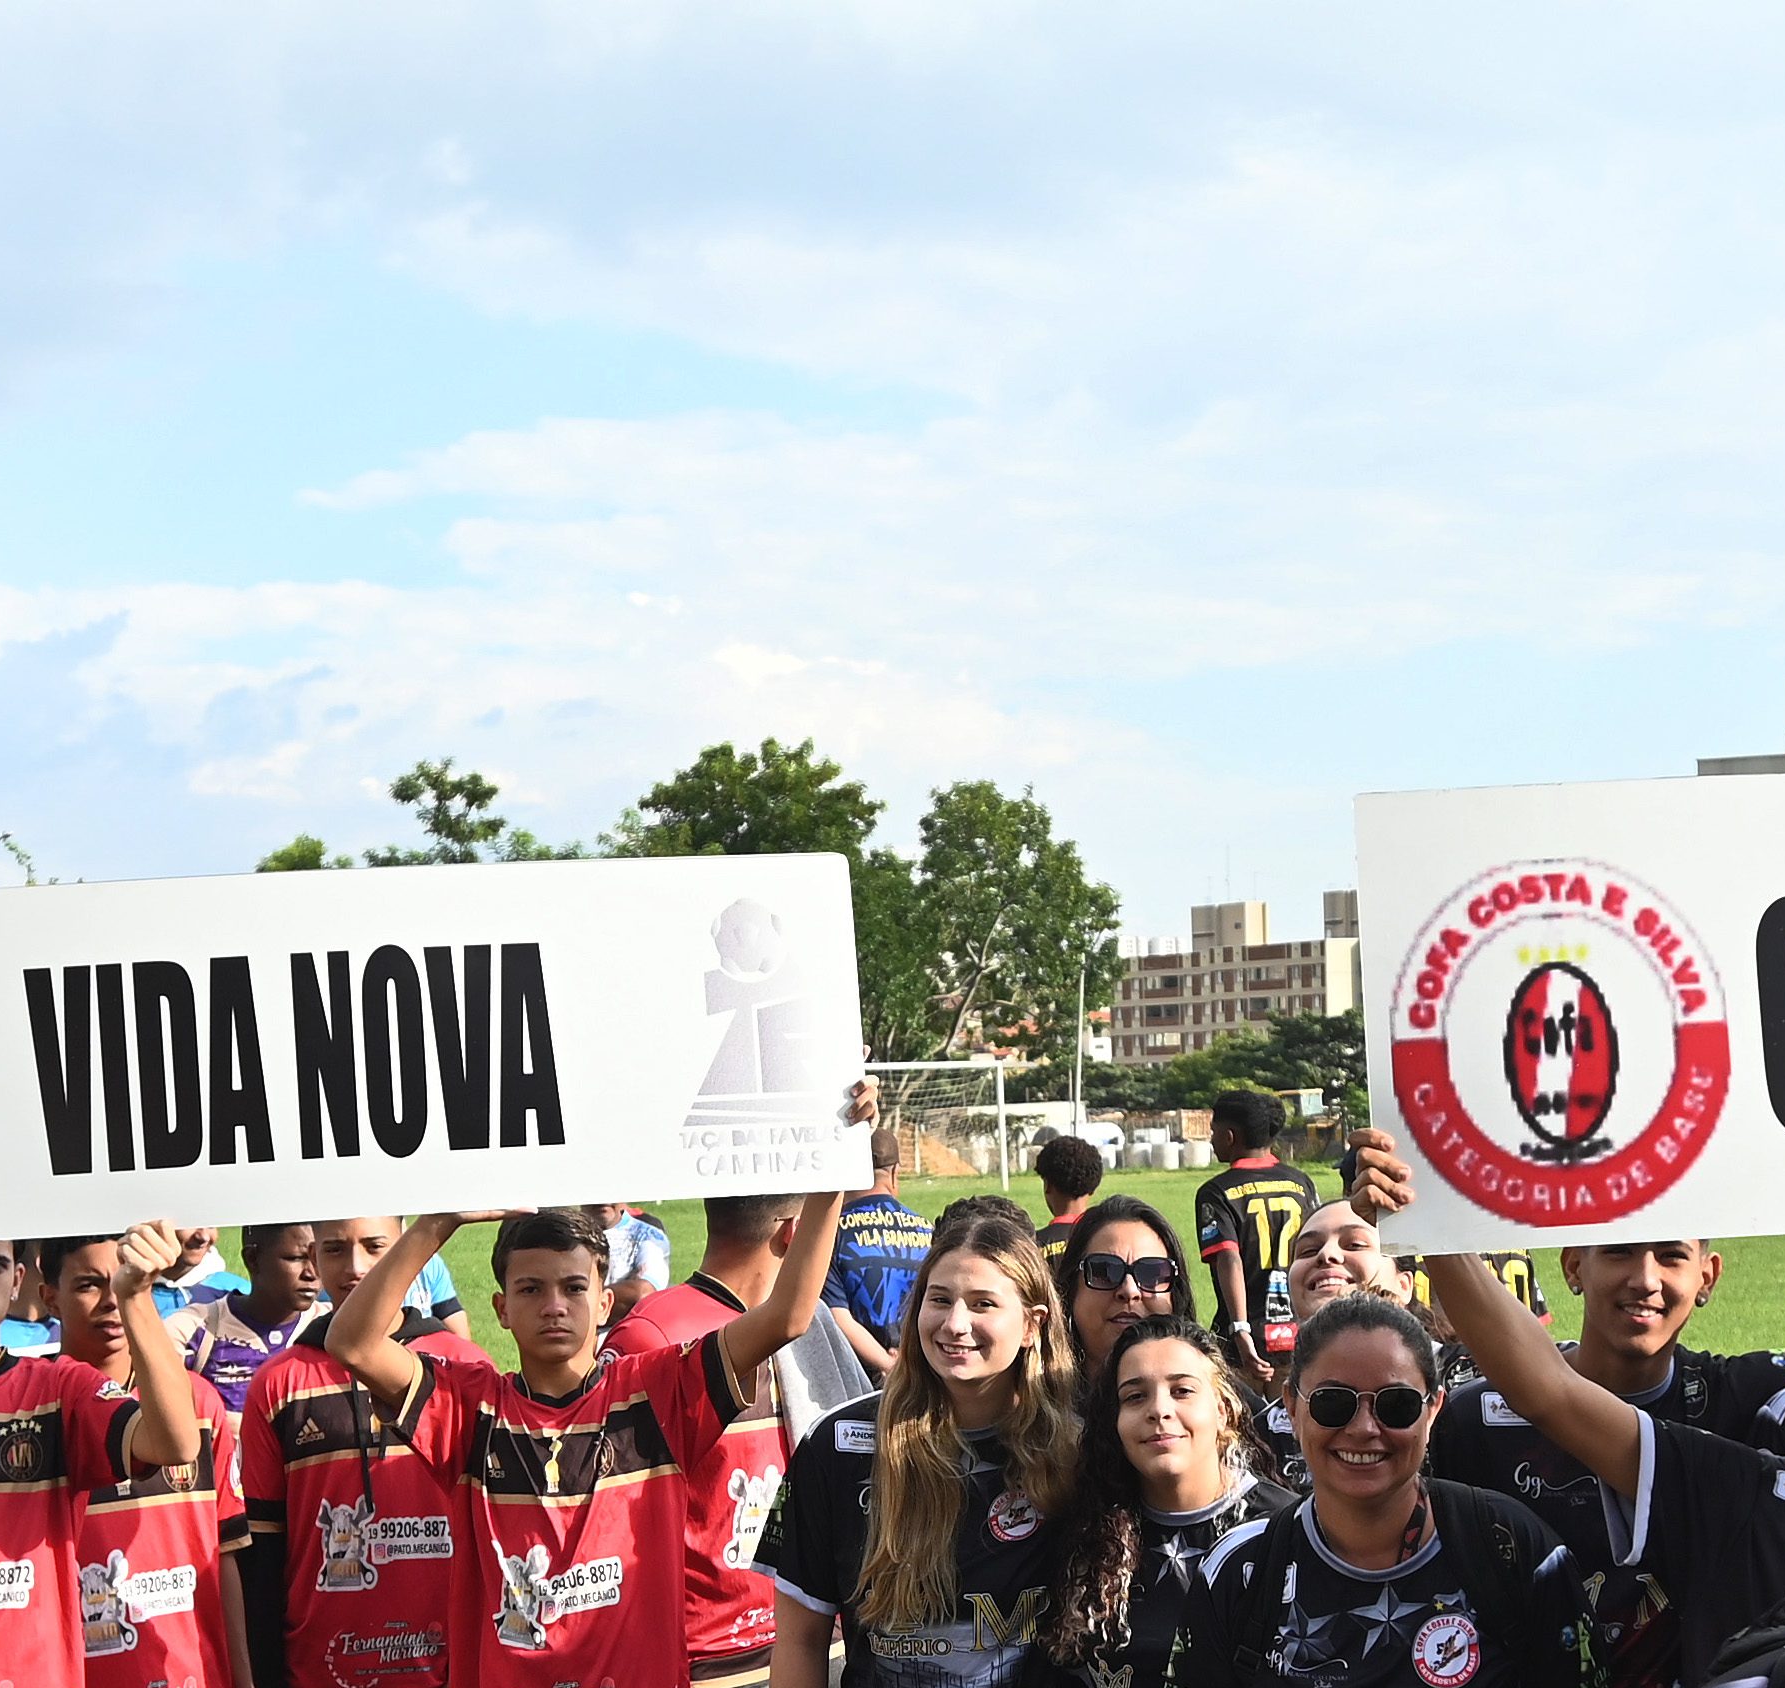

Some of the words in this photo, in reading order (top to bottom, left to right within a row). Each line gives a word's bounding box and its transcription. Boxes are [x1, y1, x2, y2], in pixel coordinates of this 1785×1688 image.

[1468, 872, 1593, 928] COSTA
[1601, 882, 1629, 919] E
[1633, 907, 1708, 1016] SILVA
[23, 955, 275, 1176] VIDA
[290, 942, 566, 1160] NOVA
[1413, 1082, 1597, 1212] CATEGORIA
[1605, 1160, 1653, 1202] DE
[1654, 1065, 1714, 1165] BASE
[854, 1228, 882, 1248] VILA
[1247, 1196, 1303, 1270] 17
[850, 1430, 876, 1440] ANDR
[368, 1528, 378, 1540] 19
[380, 1521, 451, 1540] 99206-887
[379, 1645, 438, 1664] Mariano
